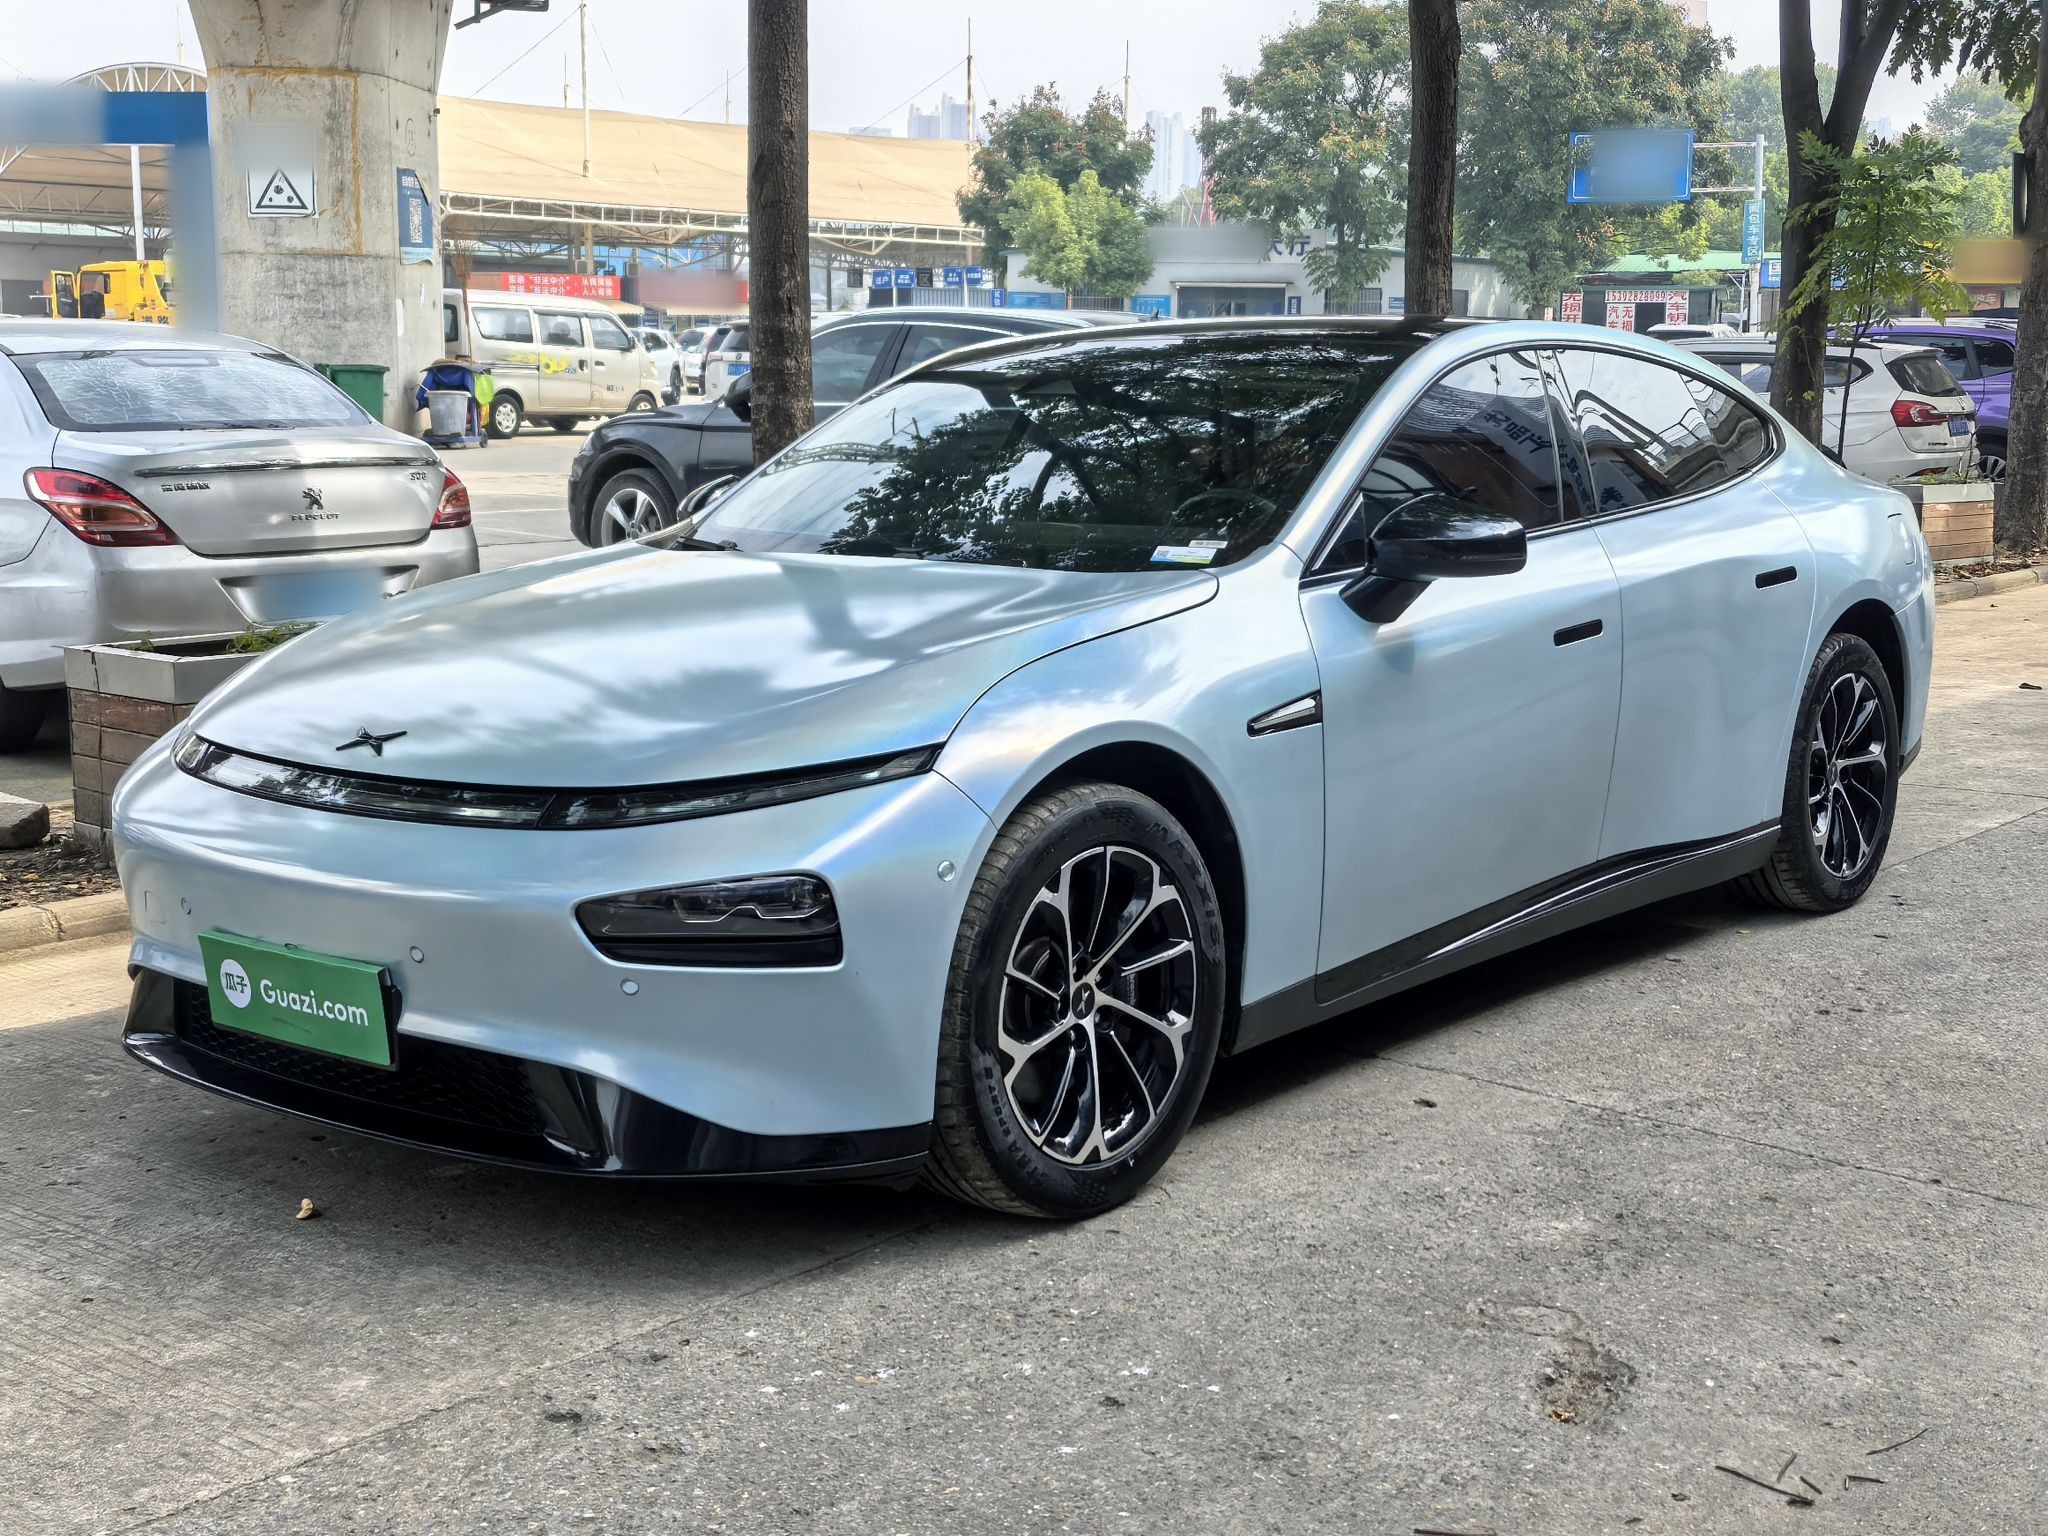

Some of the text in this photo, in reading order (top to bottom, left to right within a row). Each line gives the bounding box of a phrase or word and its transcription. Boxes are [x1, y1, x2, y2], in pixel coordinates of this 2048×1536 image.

[1747, 203, 1760, 257] 面包车专区
[1668, 290, 1687, 325] 汽车钥
[225, 972, 247, 994] 瓜子
[260, 979, 369, 1027] Guazi.com
